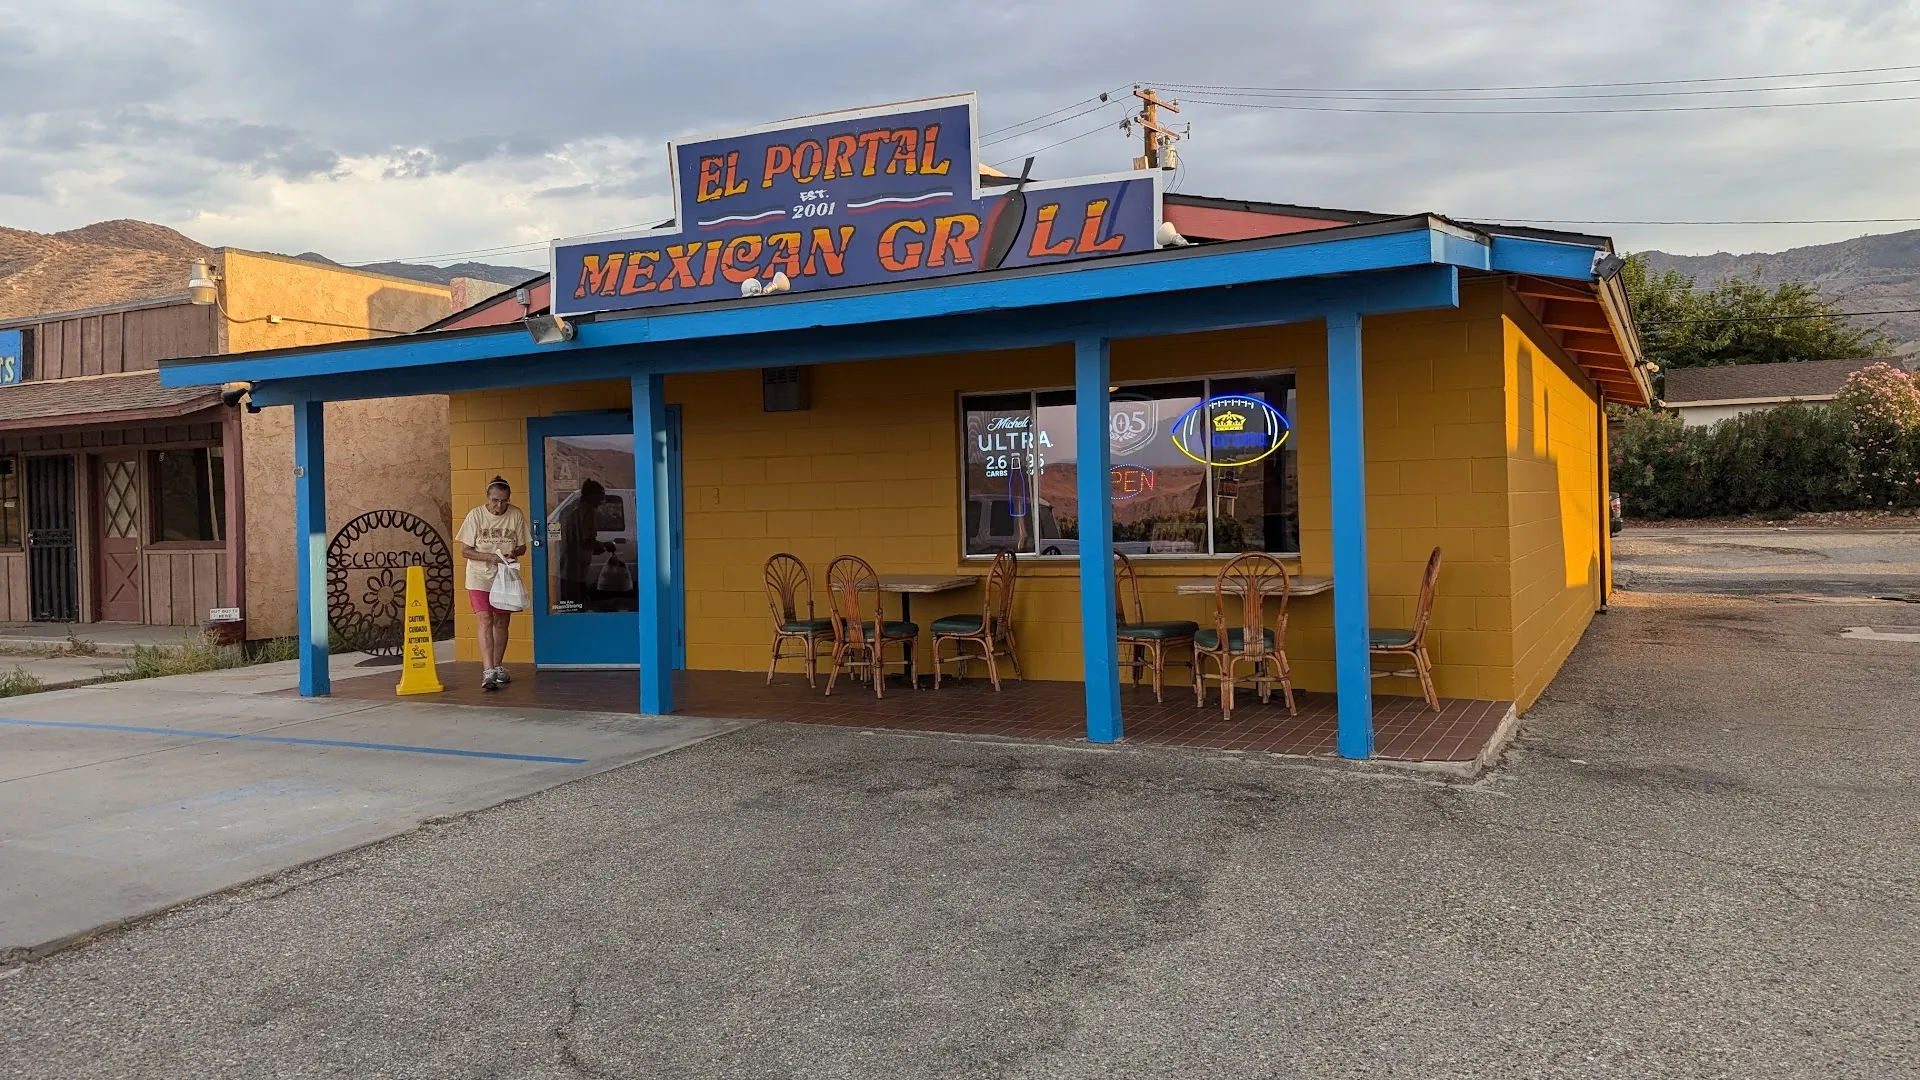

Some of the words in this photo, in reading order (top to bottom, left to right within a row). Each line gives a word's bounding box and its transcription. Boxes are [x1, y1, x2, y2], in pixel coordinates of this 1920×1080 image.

[697, 151, 749, 203] EL
[761, 123, 950, 189] PORTAL
[799, 188, 830, 201] EST.
[791, 202, 836, 219] 2001
[573, 224, 856, 299] MEXICAN
[1109, 411, 1146, 434] 05
[978, 430, 1051, 452] ULTRA
[986, 455, 1008, 470] 2.6
[1110, 470, 1154, 492] PEN
[408, 636, 430, 644] ATTENTION
